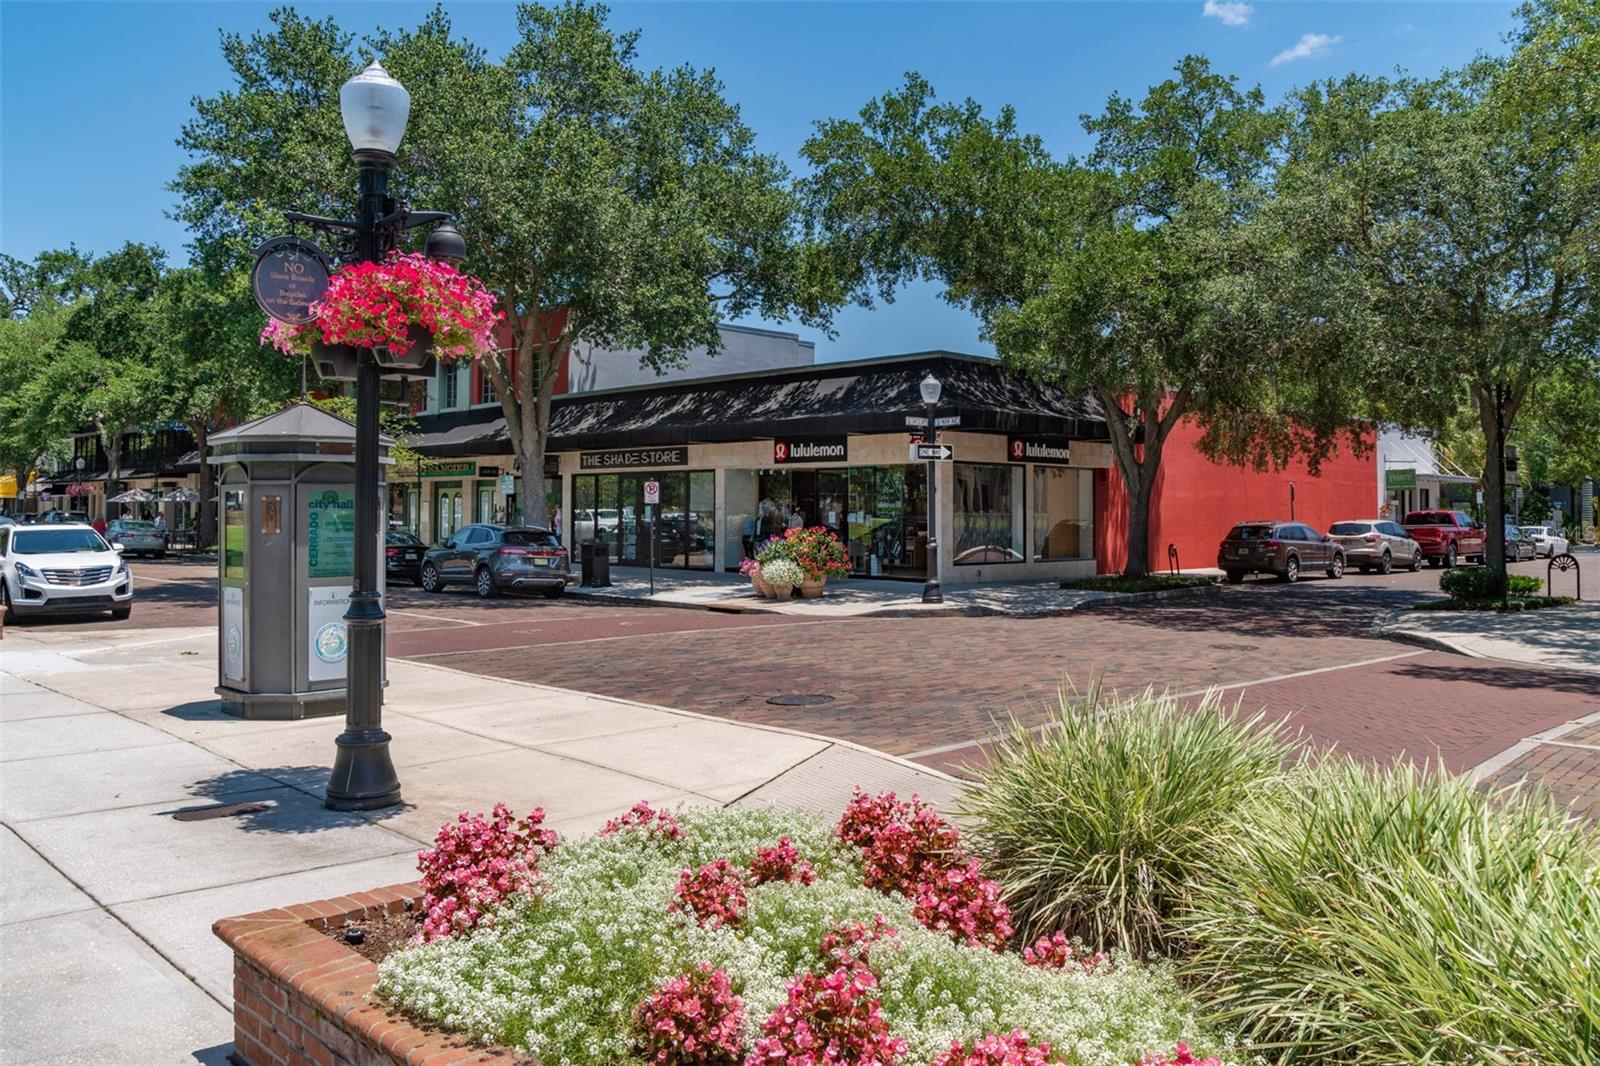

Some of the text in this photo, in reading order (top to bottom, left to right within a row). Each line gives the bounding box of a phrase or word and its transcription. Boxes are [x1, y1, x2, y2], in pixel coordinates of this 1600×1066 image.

[284, 262, 304, 273] NO
[582, 450, 681, 466] THE SHADE STORE
[790, 442, 844, 458] lululemon
[931, 449, 941, 457] WAY
[1026, 442, 1070, 459] lululemon
[309, 498, 354, 511] city hall
[309, 512, 318, 567] CERRADO
